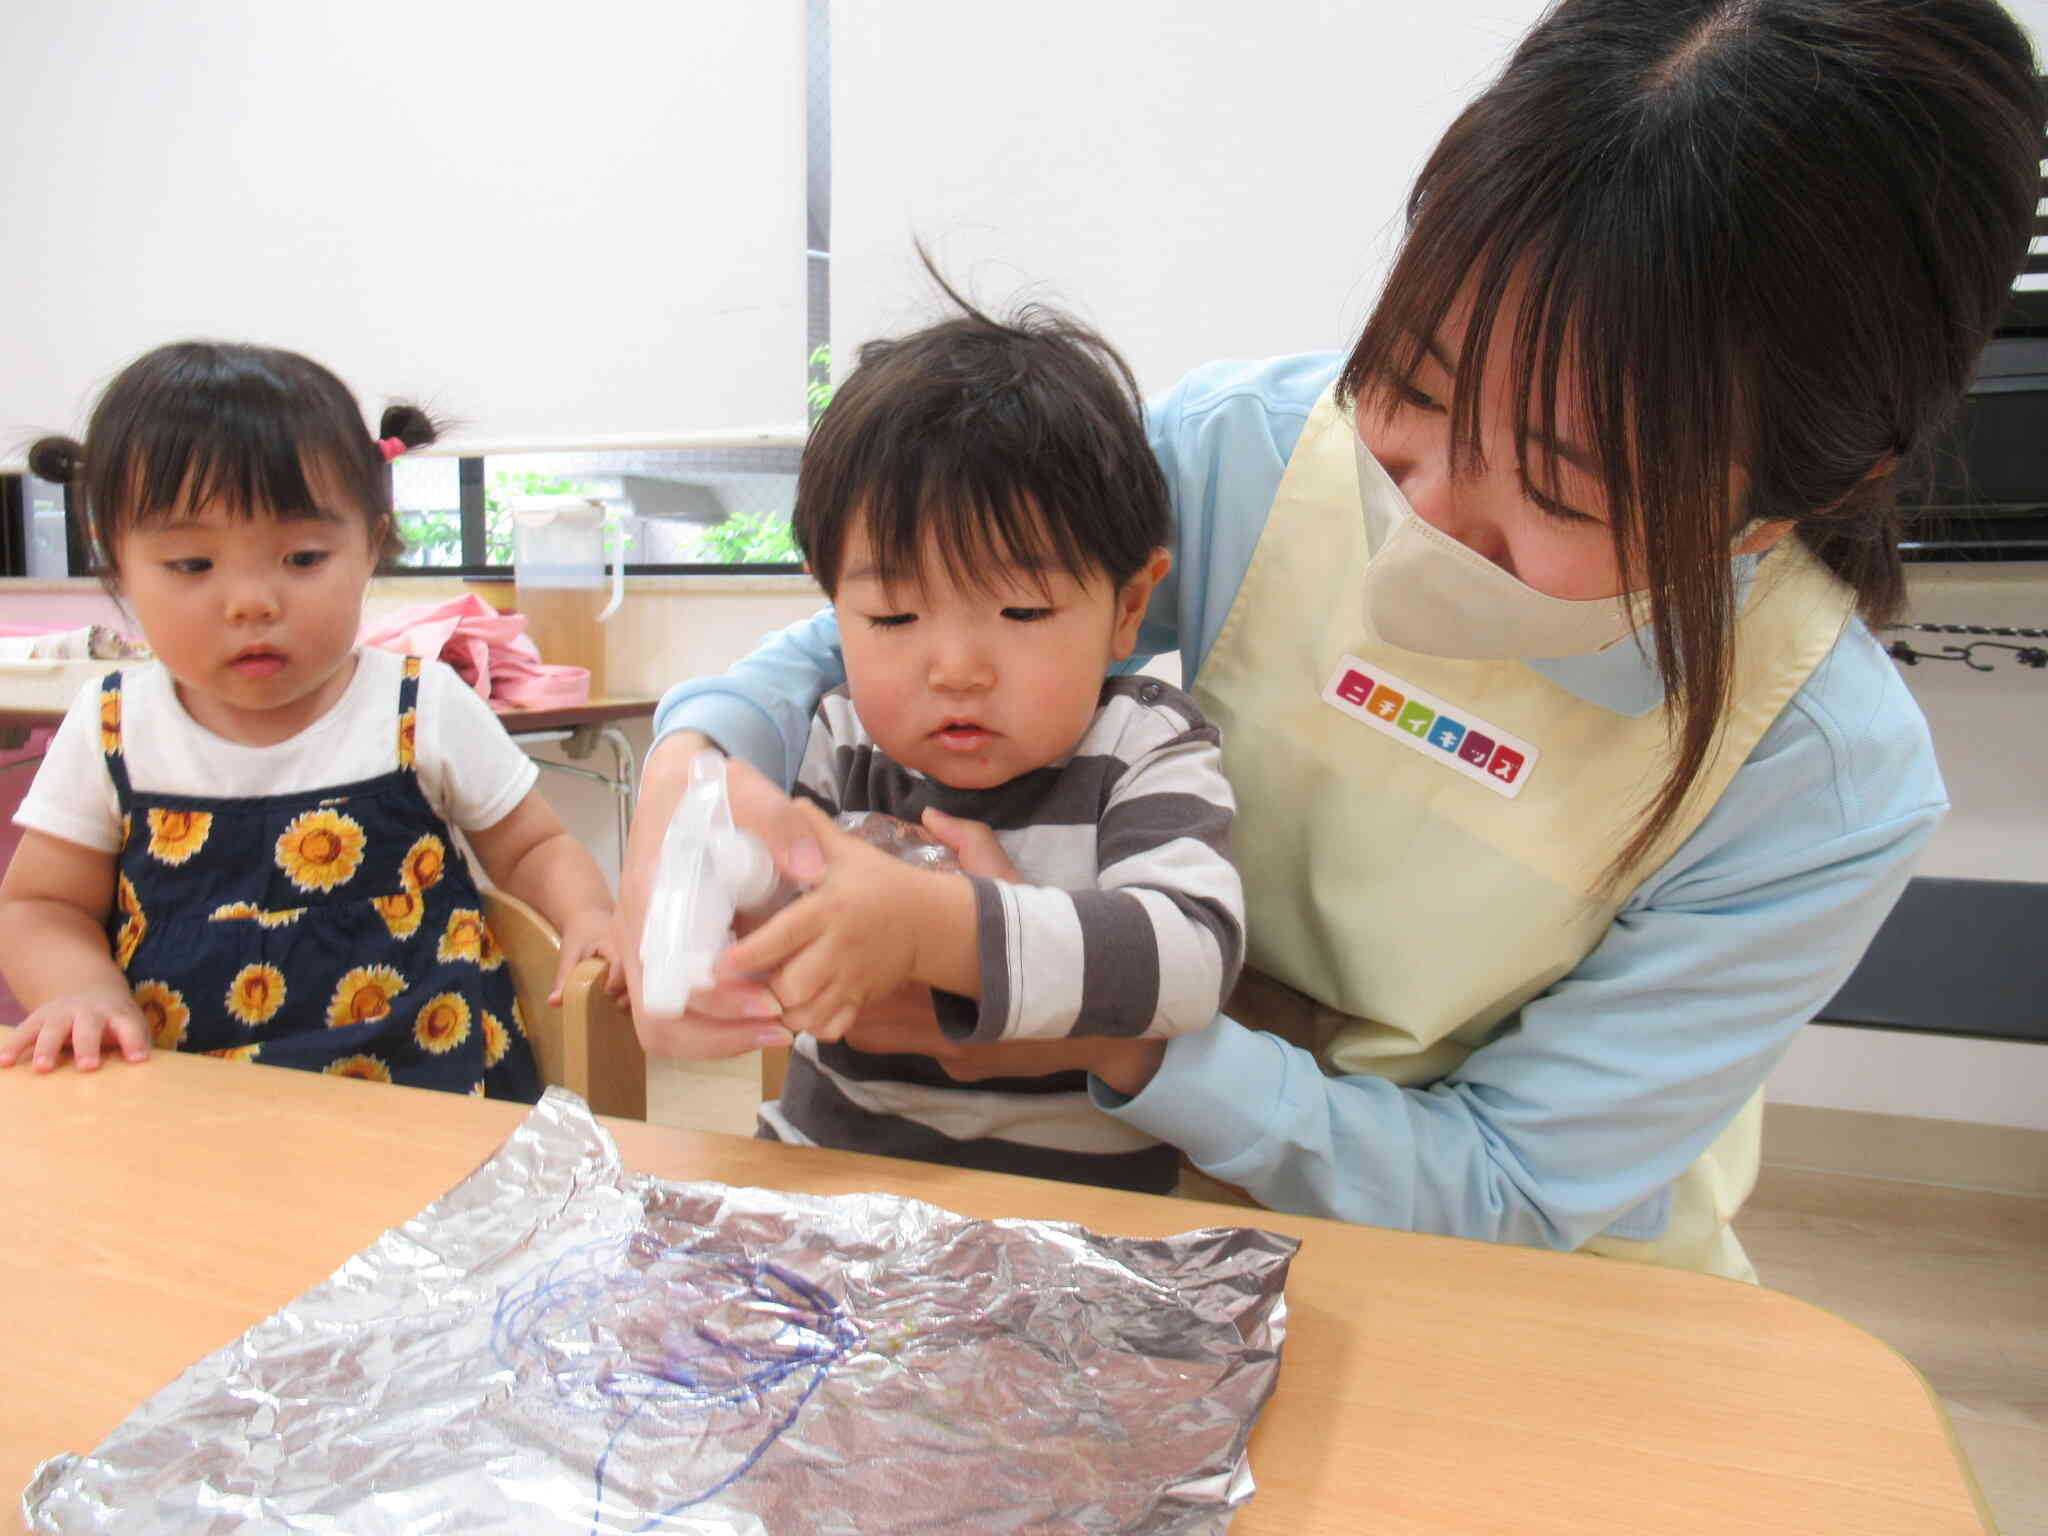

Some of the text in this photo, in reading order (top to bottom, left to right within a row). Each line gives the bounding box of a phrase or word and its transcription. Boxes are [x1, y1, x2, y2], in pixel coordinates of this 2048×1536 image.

[1343, 682, 1519, 780] ニチイキッズ
